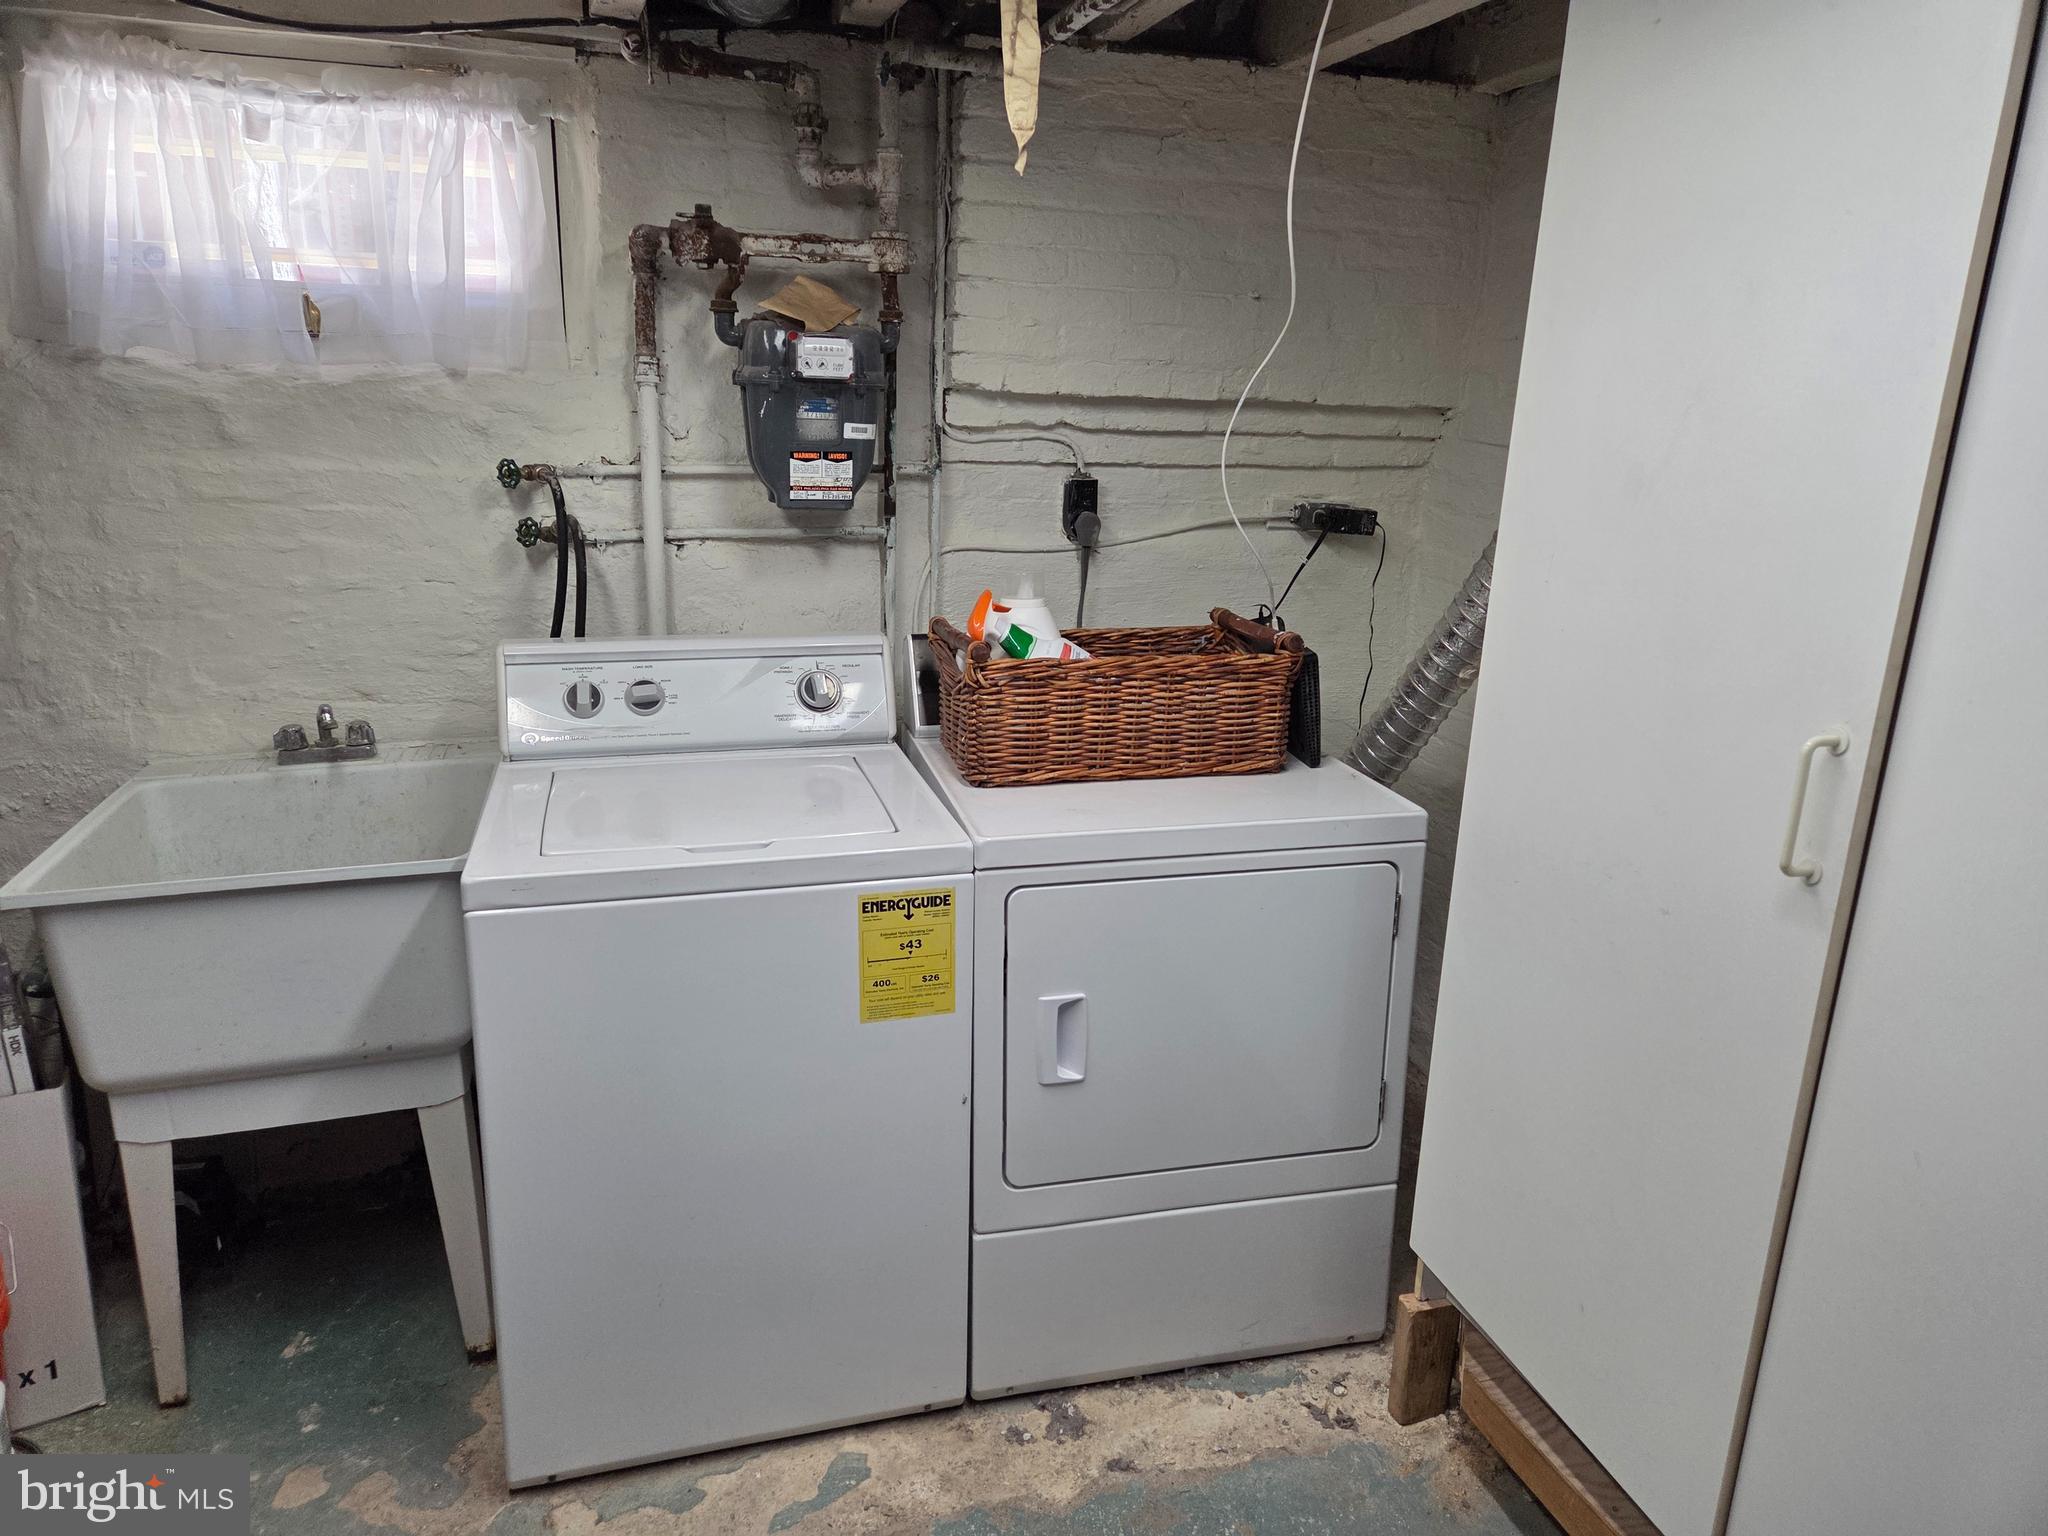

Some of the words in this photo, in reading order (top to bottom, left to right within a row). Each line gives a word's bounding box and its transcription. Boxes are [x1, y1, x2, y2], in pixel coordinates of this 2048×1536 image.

[540, 735, 564, 743] Speed
[862, 895, 951, 914] ENERGYGUIDE
[899, 938, 922, 951] $43
[872, 979, 891, 988] 400
[922, 974, 940, 983] $26
[8, 1035, 23, 1056] HDX
[44, 1359, 58, 1380] 1
